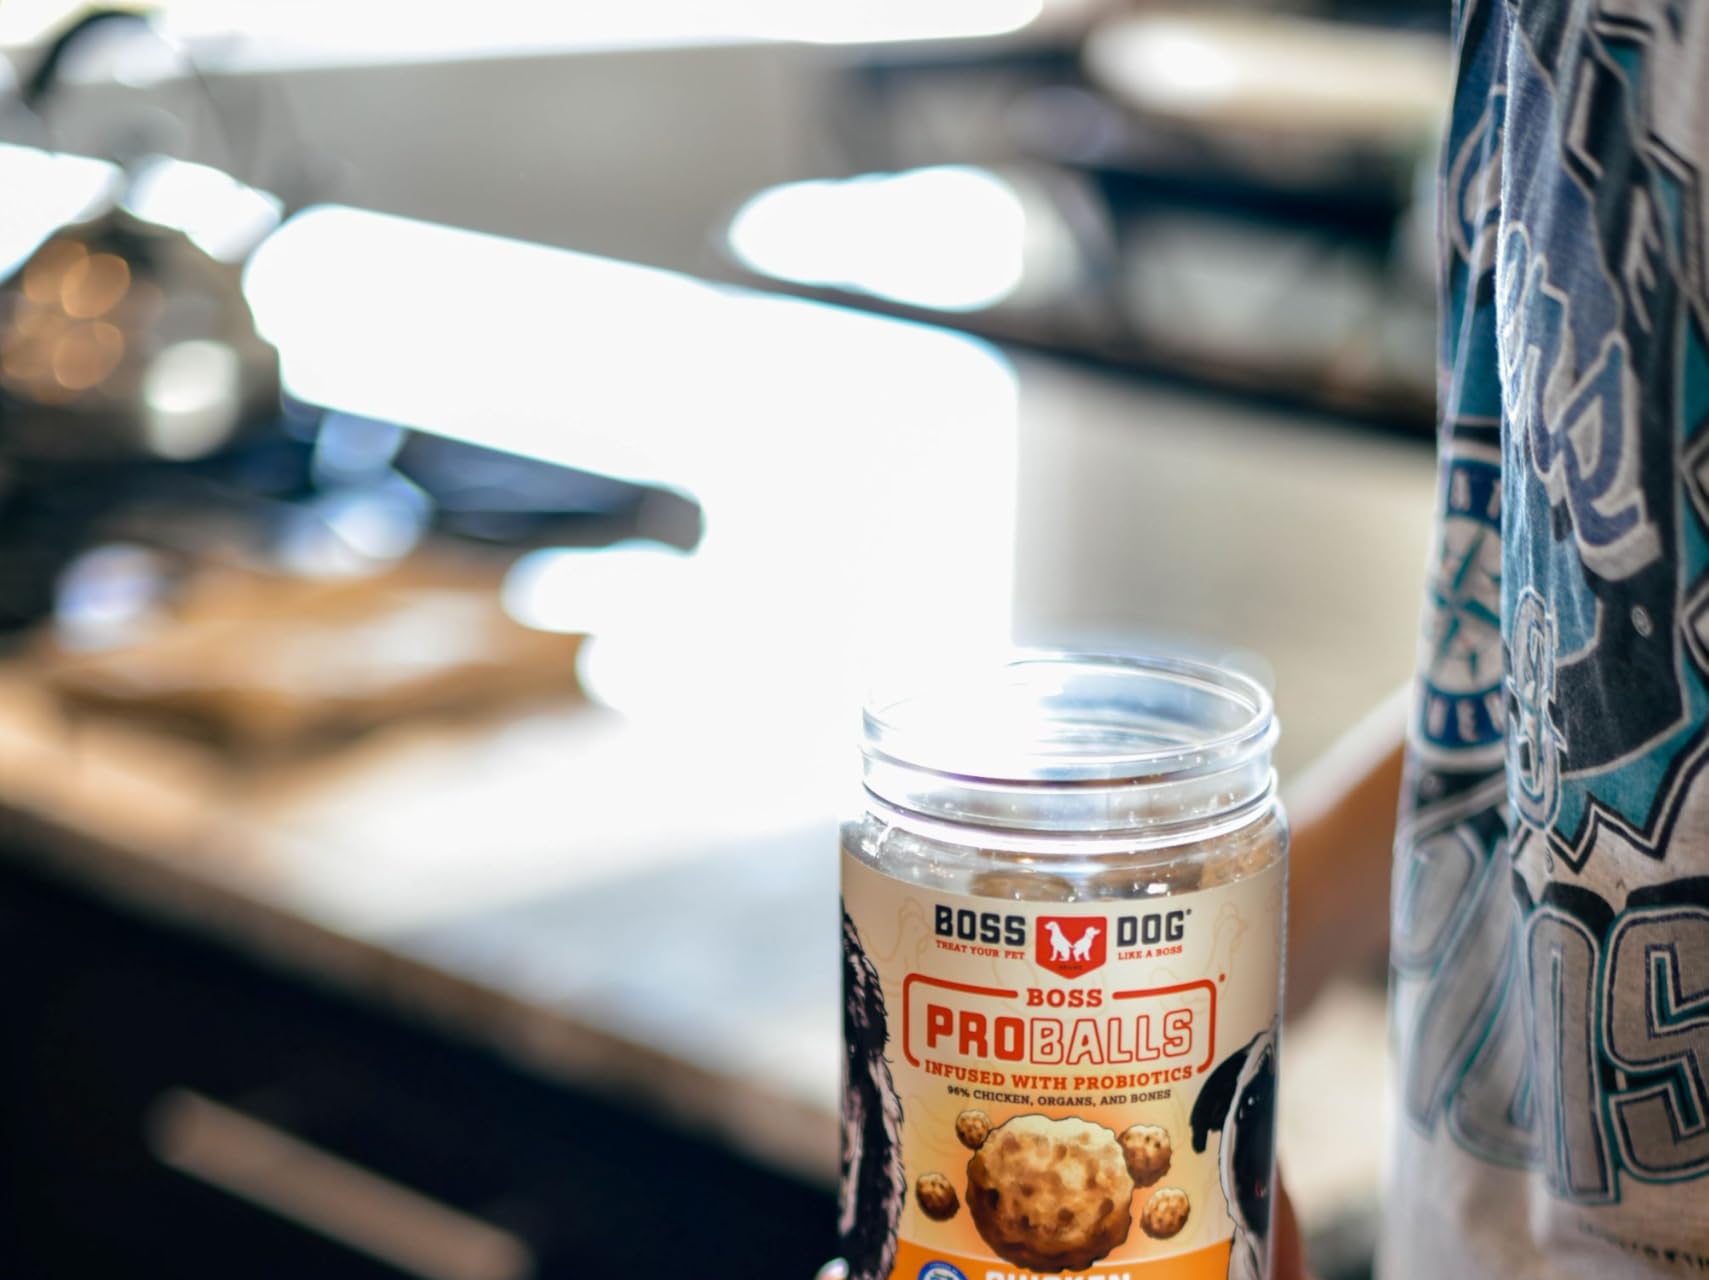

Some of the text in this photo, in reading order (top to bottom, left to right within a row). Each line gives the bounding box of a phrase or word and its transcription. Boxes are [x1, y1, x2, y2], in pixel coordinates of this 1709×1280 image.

[935, 904, 1184, 947] BOSS DOG
[936, 940, 1025, 960] TREAT YOUR PET
[1118, 945, 1183, 960] LIKE A BOSS
[1026, 988, 1102, 1008] BOSS
[927, 1004, 1192, 1065] PROBALLS
[925, 1060, 1192, 1090] INFUSED WITH PROBIOTICS
[947, 1085, 1171, 1107] 96% CHICKEN, ORGANS, AND BONES
